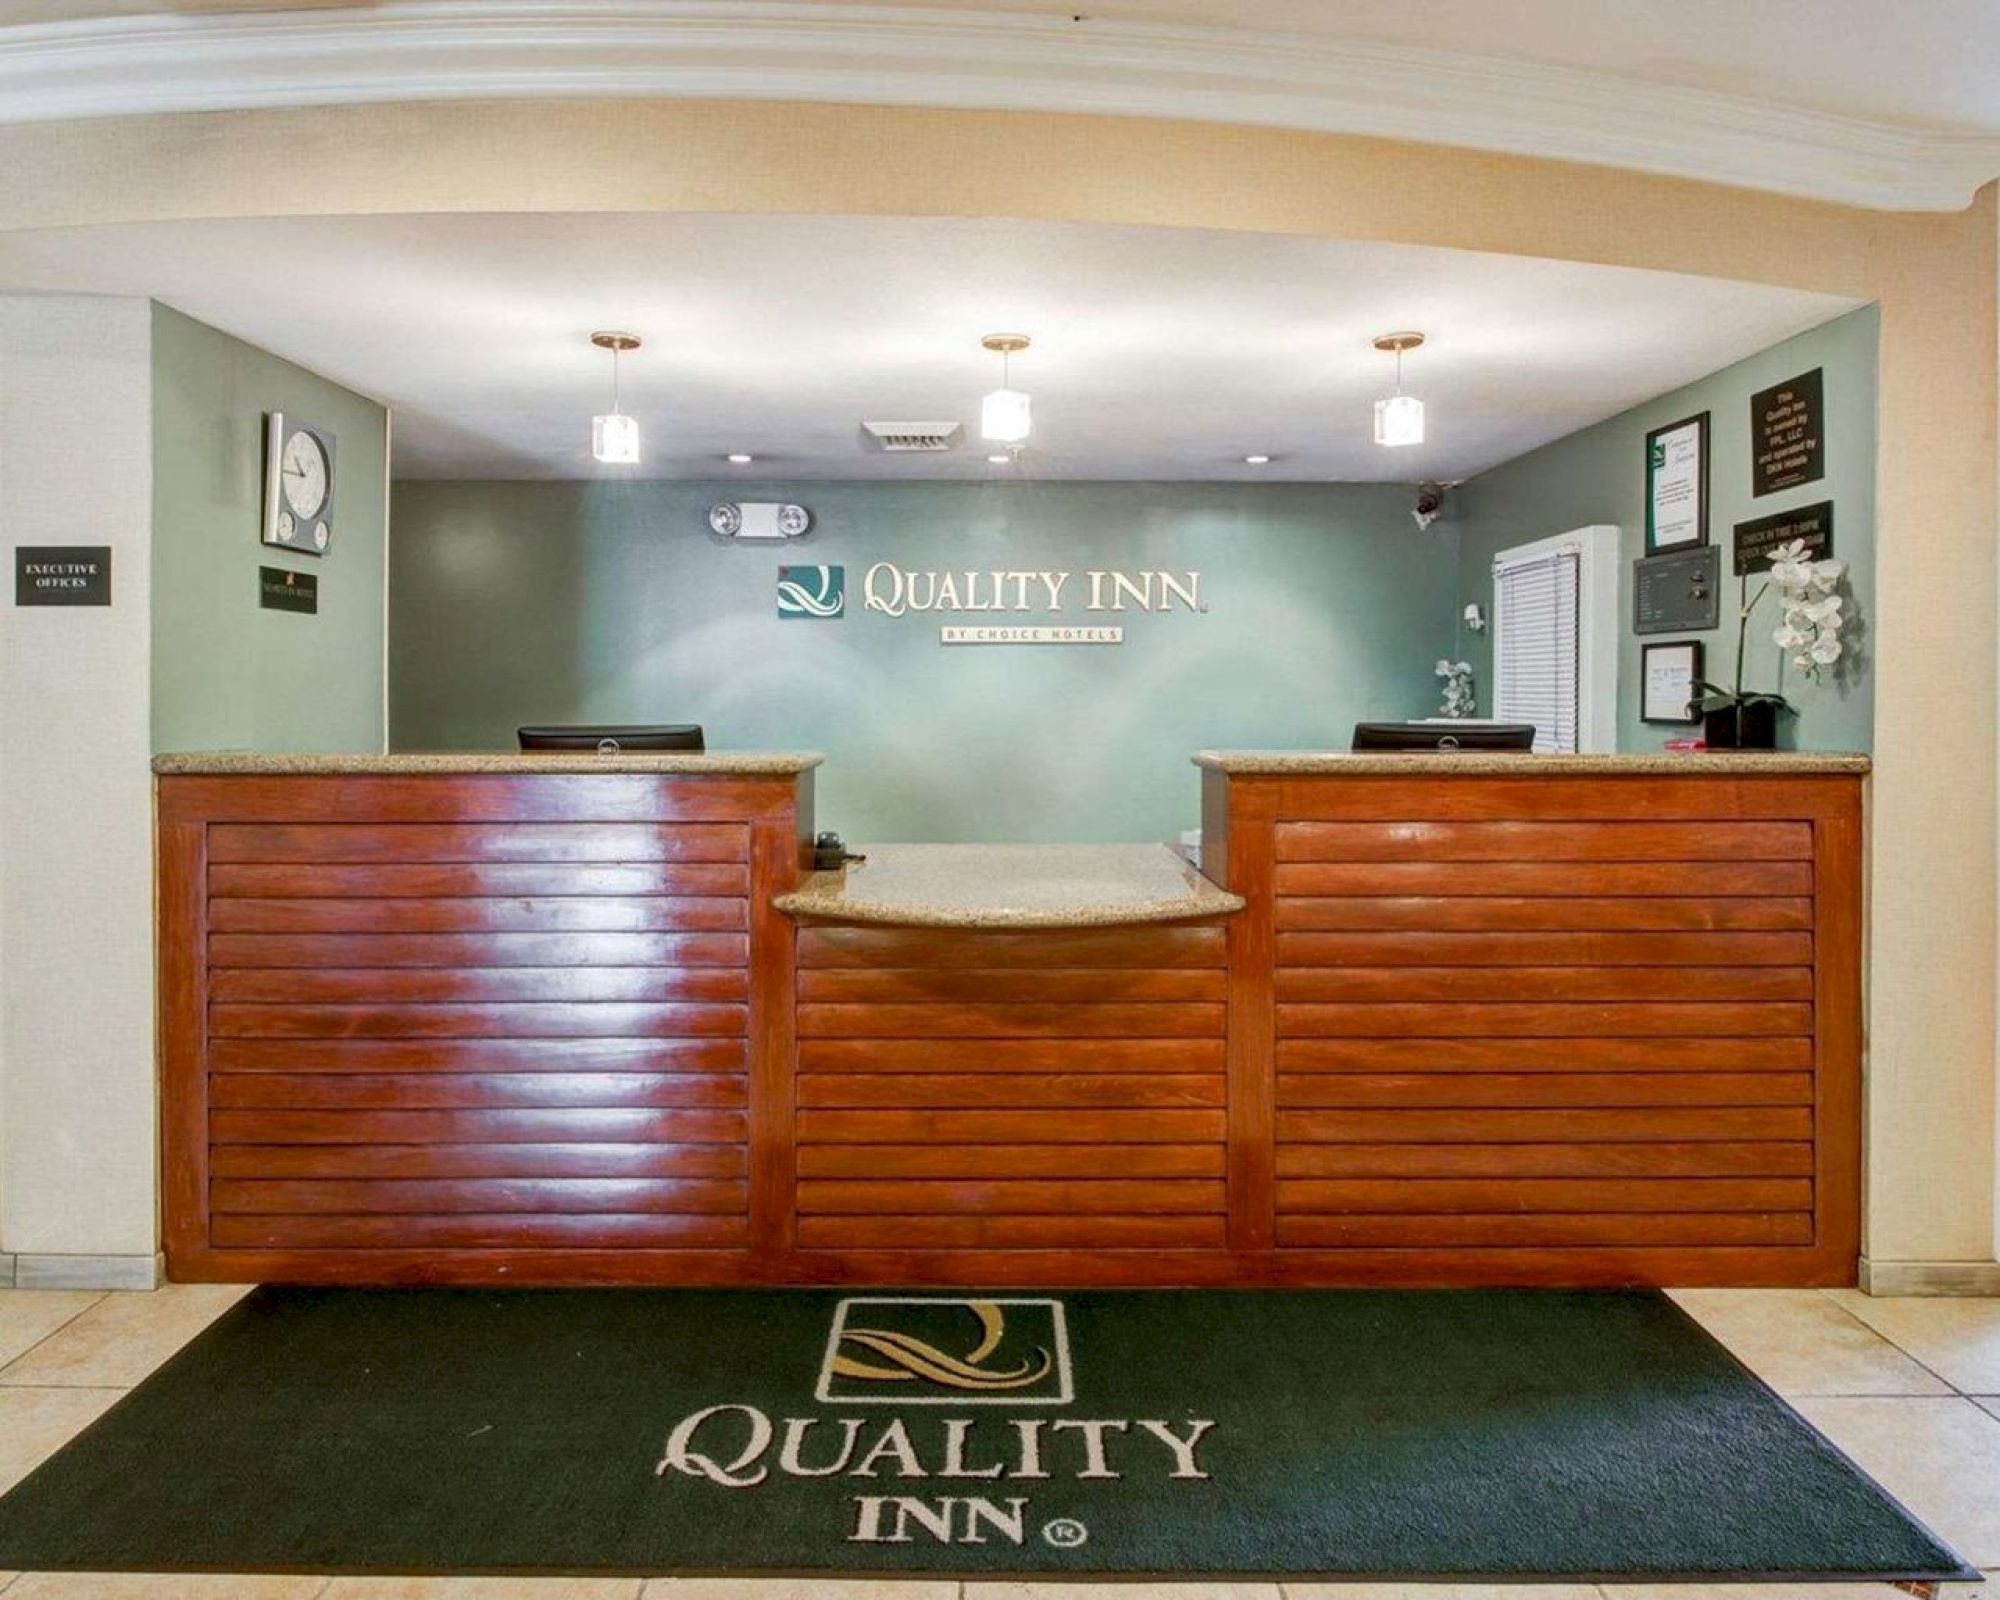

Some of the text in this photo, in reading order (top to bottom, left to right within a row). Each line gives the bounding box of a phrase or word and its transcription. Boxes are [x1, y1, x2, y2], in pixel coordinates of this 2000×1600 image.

[25, 563, 98, 575] EXECUTIVE
[35, 577, 87, 588] OFFICES
[863, 561, 1201, 617] QUALITY INN
[947, 629, 1118, 640] BY CHOICE HOTELS
[656, 1403, 1219, 1488] QUALITY
[846, 1495, 1029, 1545] INN
